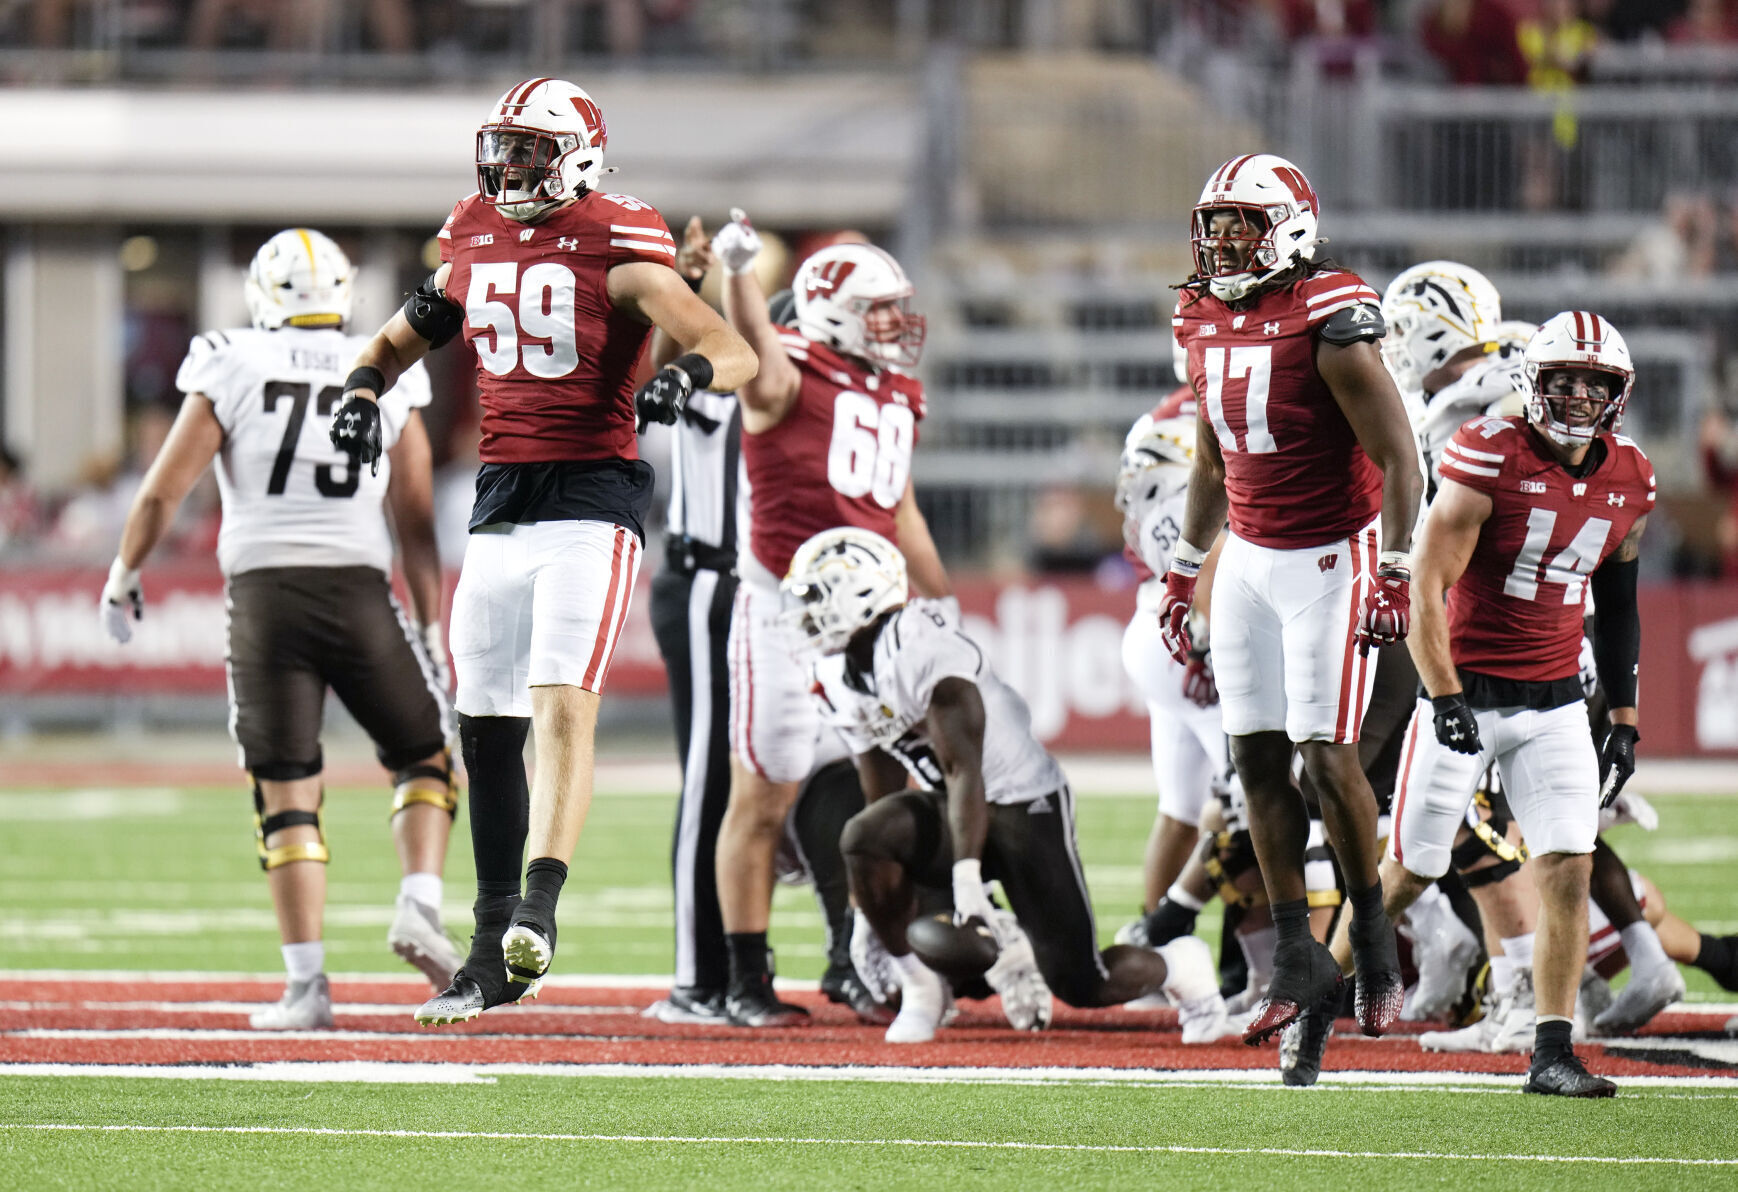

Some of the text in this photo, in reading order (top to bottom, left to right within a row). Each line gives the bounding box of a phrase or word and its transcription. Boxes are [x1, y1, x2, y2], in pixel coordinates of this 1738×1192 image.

[520, 229, 535, 243] W
[465, 262, 579, 379] 59
[263, 380, 361, 498] 73
[1204, 345, 1278, 454] 17
[827, 391, 914, 508] 68
[1572, 483, 1587, 497] W
[1152, 516, 1180, 551] 53
[1318, 554, 1338, 573] W
[1503, 507, 1612, 605] 14
